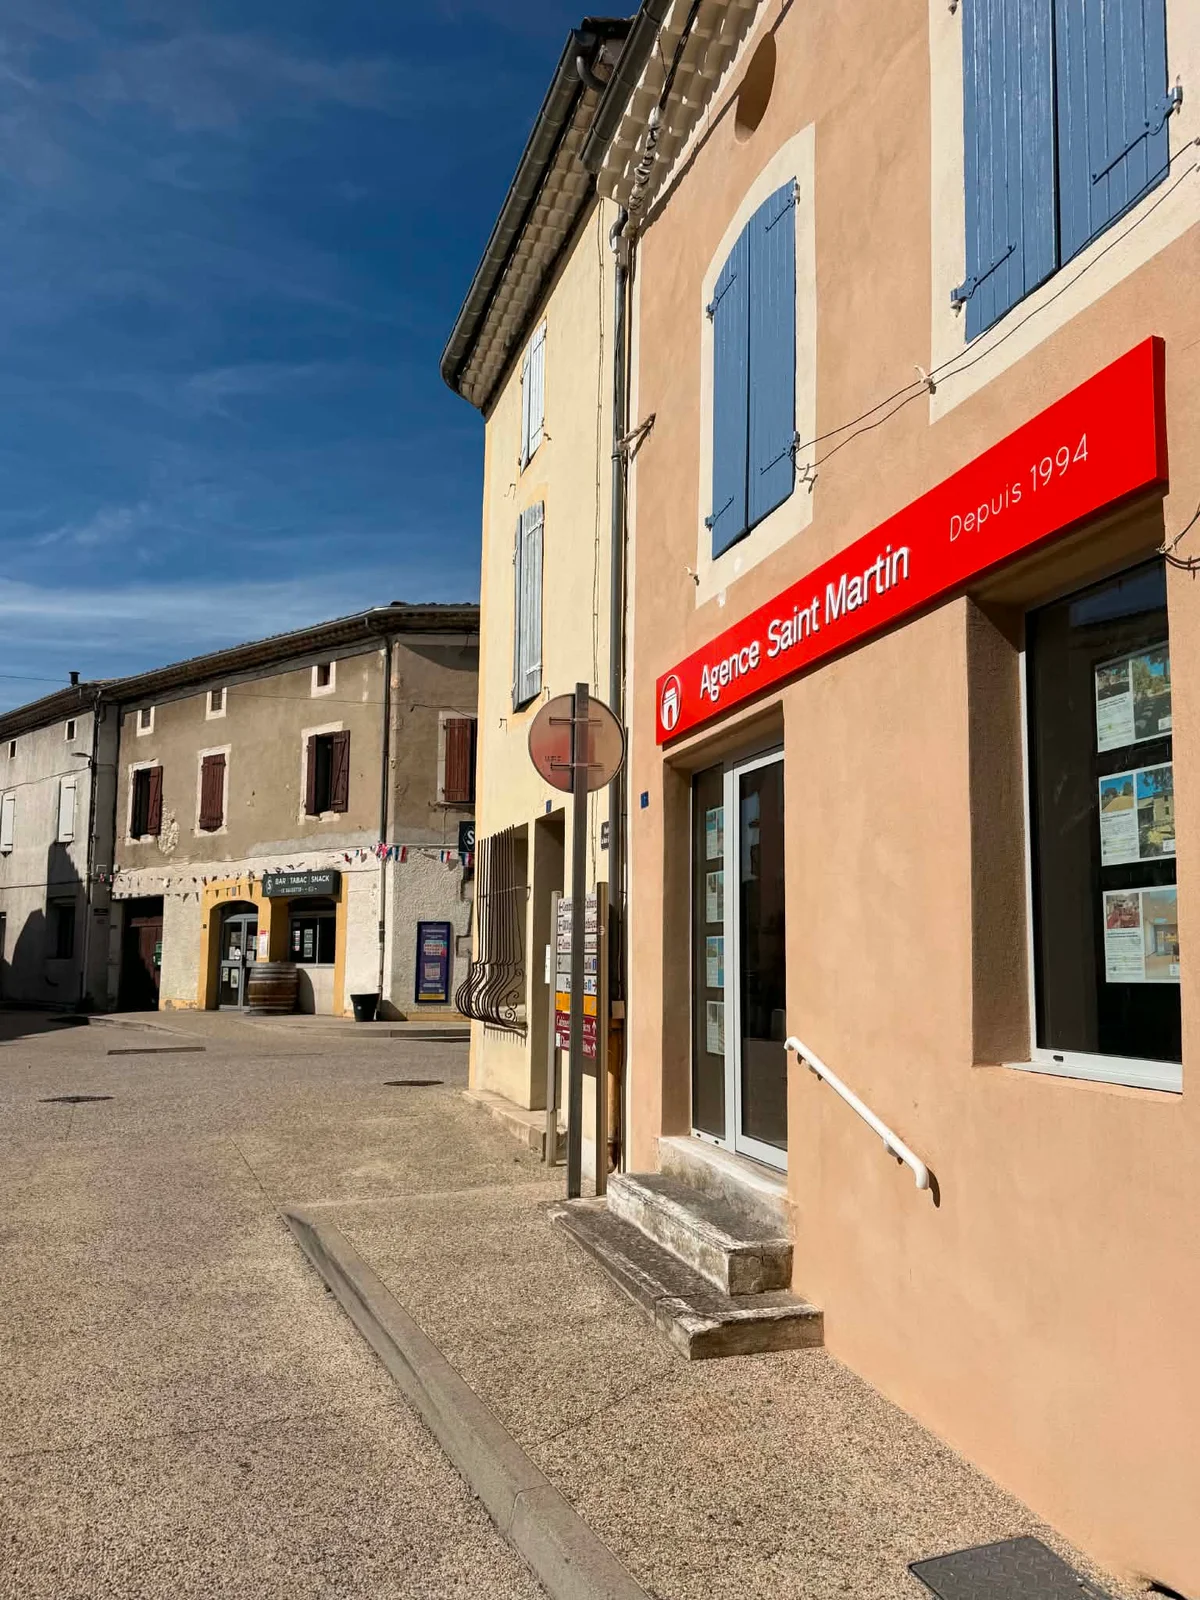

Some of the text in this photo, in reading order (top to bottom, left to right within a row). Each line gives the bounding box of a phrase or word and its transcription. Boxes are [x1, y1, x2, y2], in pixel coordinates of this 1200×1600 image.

[950, 433, 1088, 542] Depuis 1994
[700, 544, 910, 701] Agence Saint Martin
[466, 830, 475, 845] S
[275, 875, 329, 885] BAR TABAC SNACK
